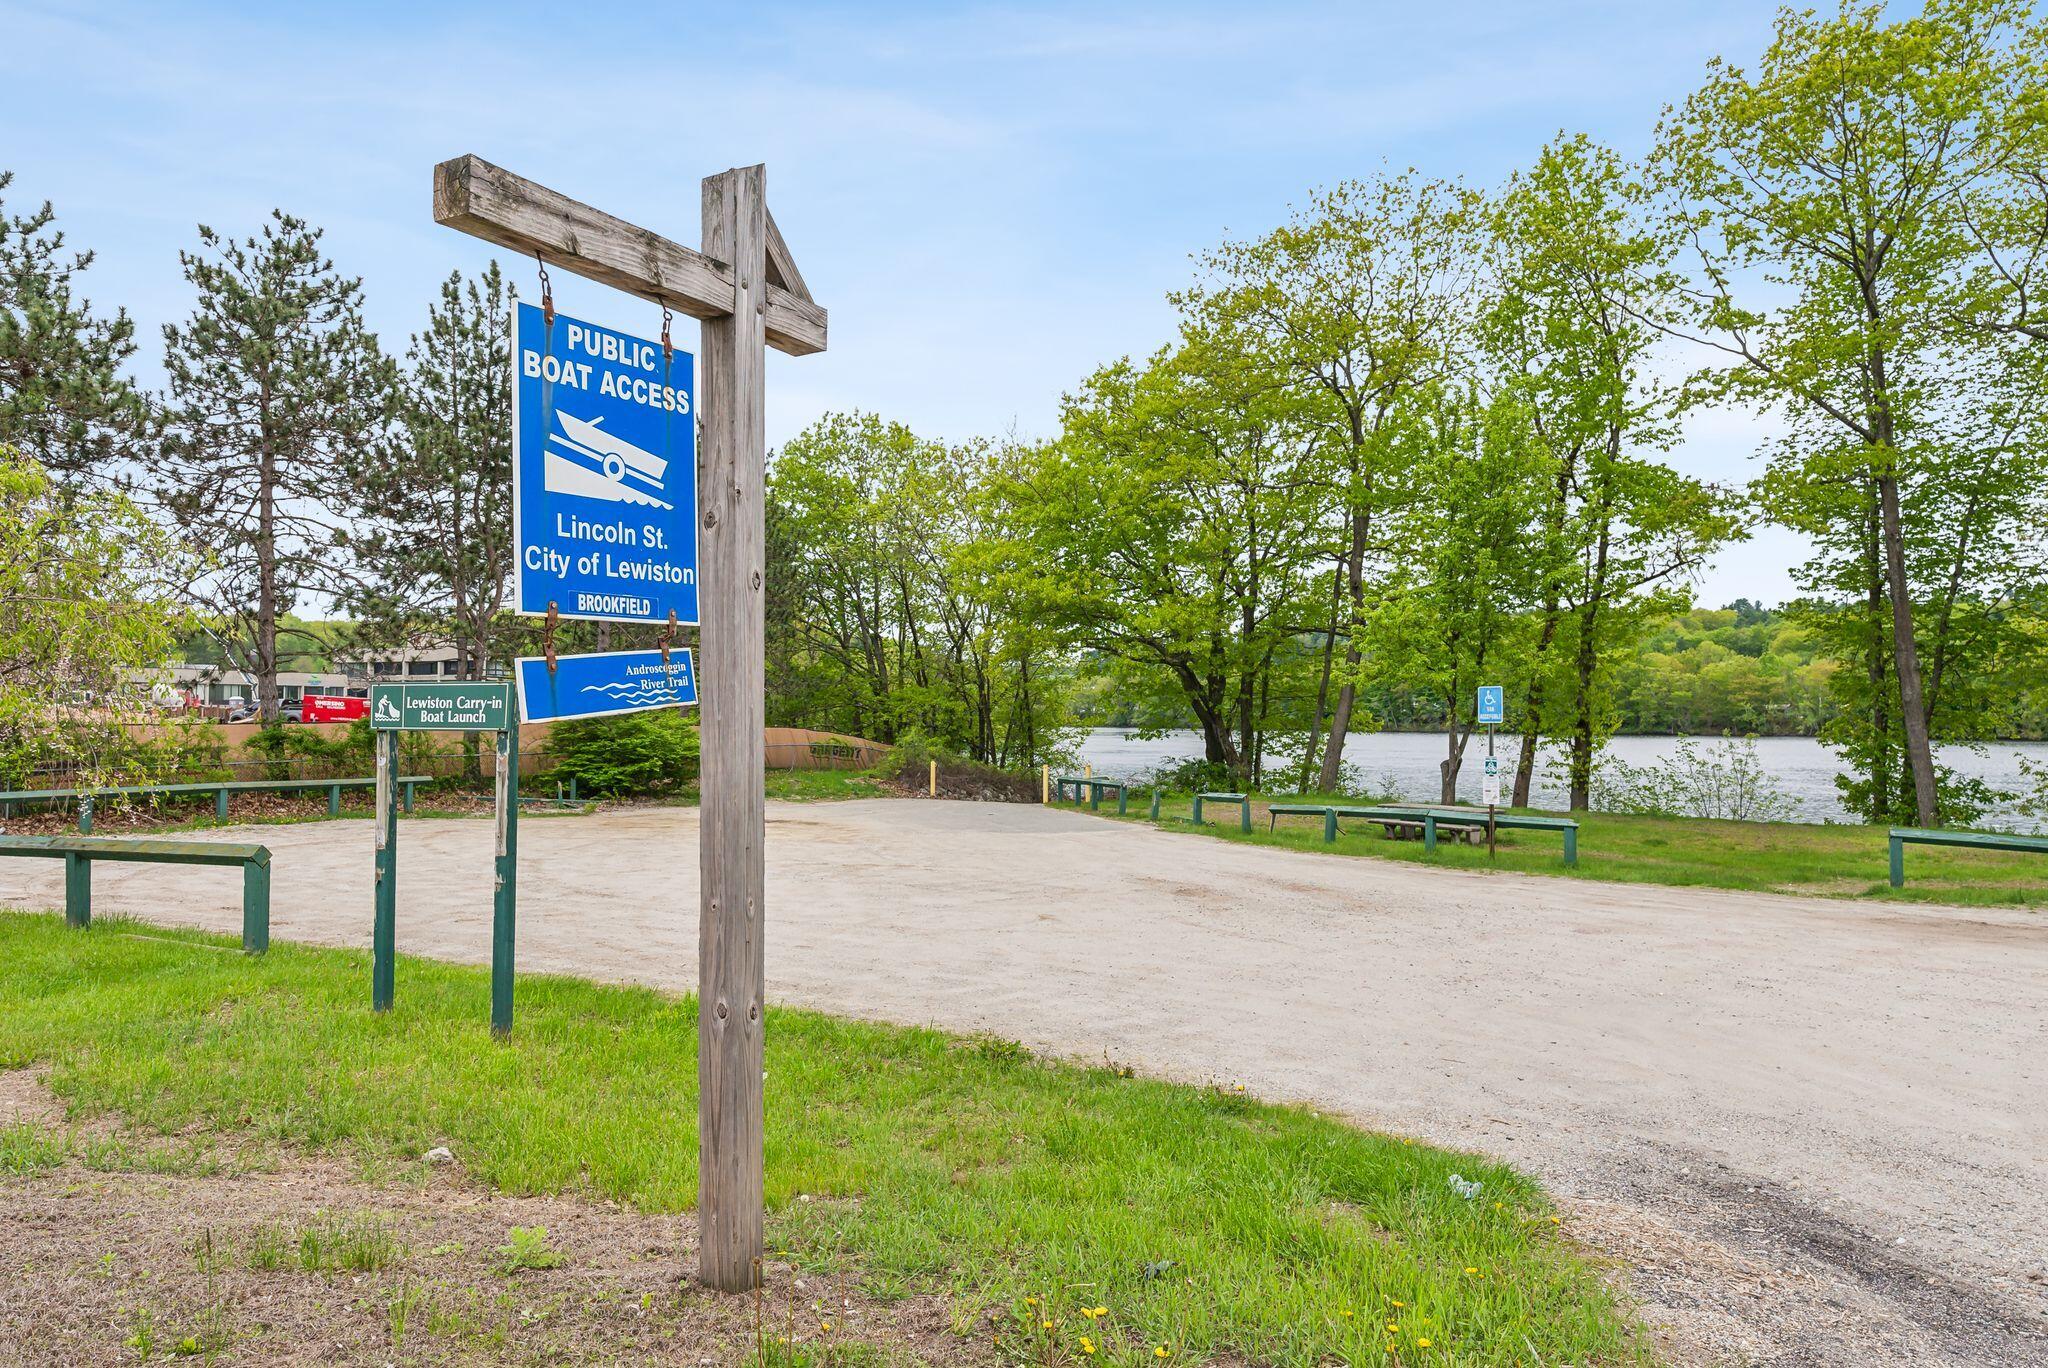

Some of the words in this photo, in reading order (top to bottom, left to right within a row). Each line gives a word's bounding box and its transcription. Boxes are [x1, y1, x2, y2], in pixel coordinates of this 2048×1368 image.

[567, 323, 656, 372] PUBLIC
[523, 349, 593, 391] BOAT
[599, 370, 690, 415] ACCESS
[556, 512, 636, 546] Lincoln
[642, 524, 669, 550] St.
[524, 545, 571, 579] City
[577, 552, 600, 576] of
[605, 553, 694, 585] Lewiston
[577, 593, 651, 616] BROOKFIELD
[625, 661, 687, 677] Androscoggin
[640, 678, 665, 691] River
[667, 675, 689, 688] Trail
[406, 695, 453, 709] Lewiston
[456, 695, 503, 712] Carry-in
[420, 710, 444, 723] Boat
[447, 709, 486, 723] Launch
